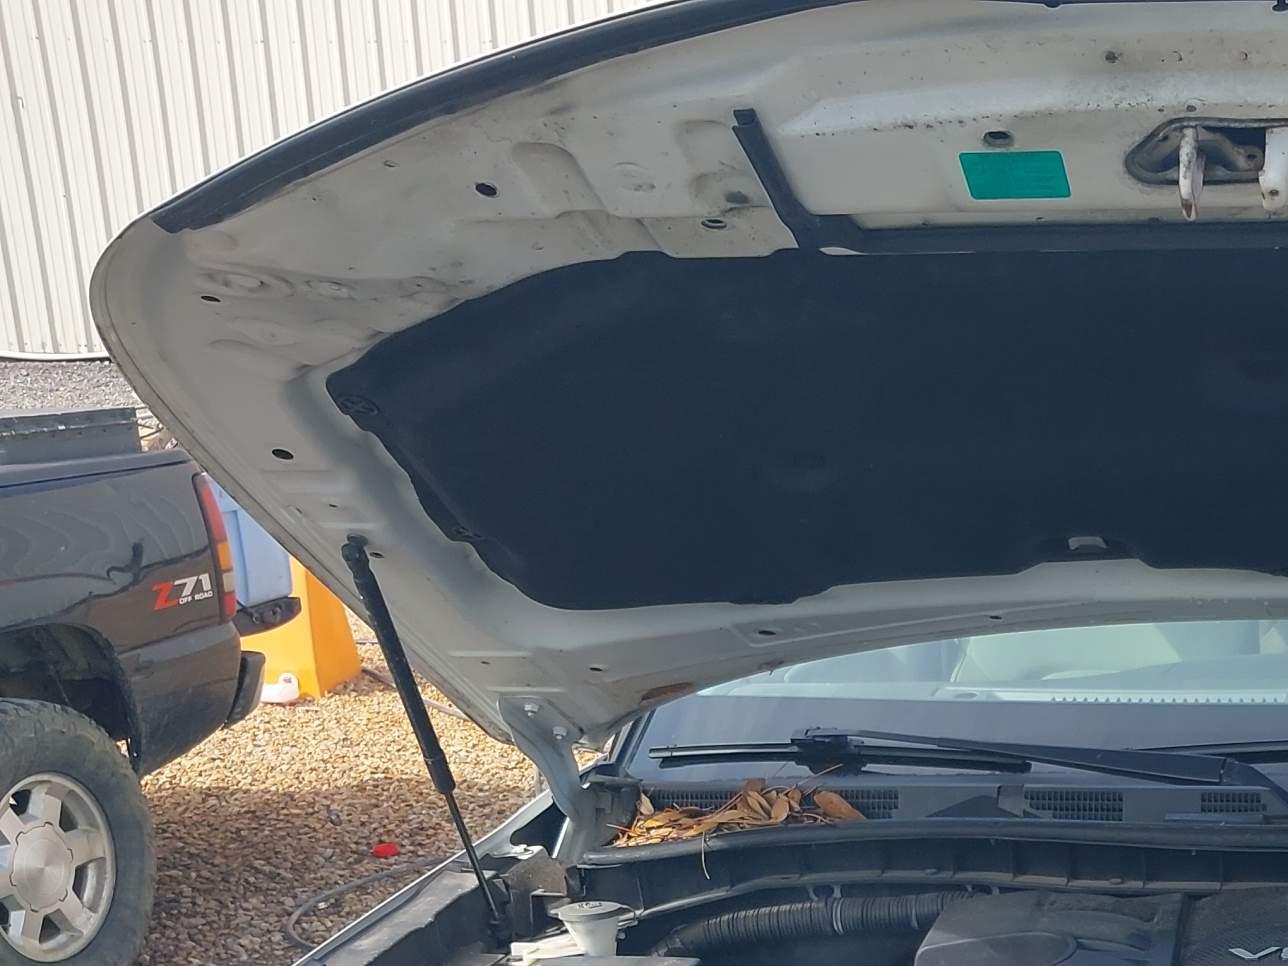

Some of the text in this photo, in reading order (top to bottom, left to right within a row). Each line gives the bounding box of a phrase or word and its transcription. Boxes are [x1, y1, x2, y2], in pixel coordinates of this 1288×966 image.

[151, 573, 212, 610] Z71
[179, 591, 213, 604] OFF ROAD
